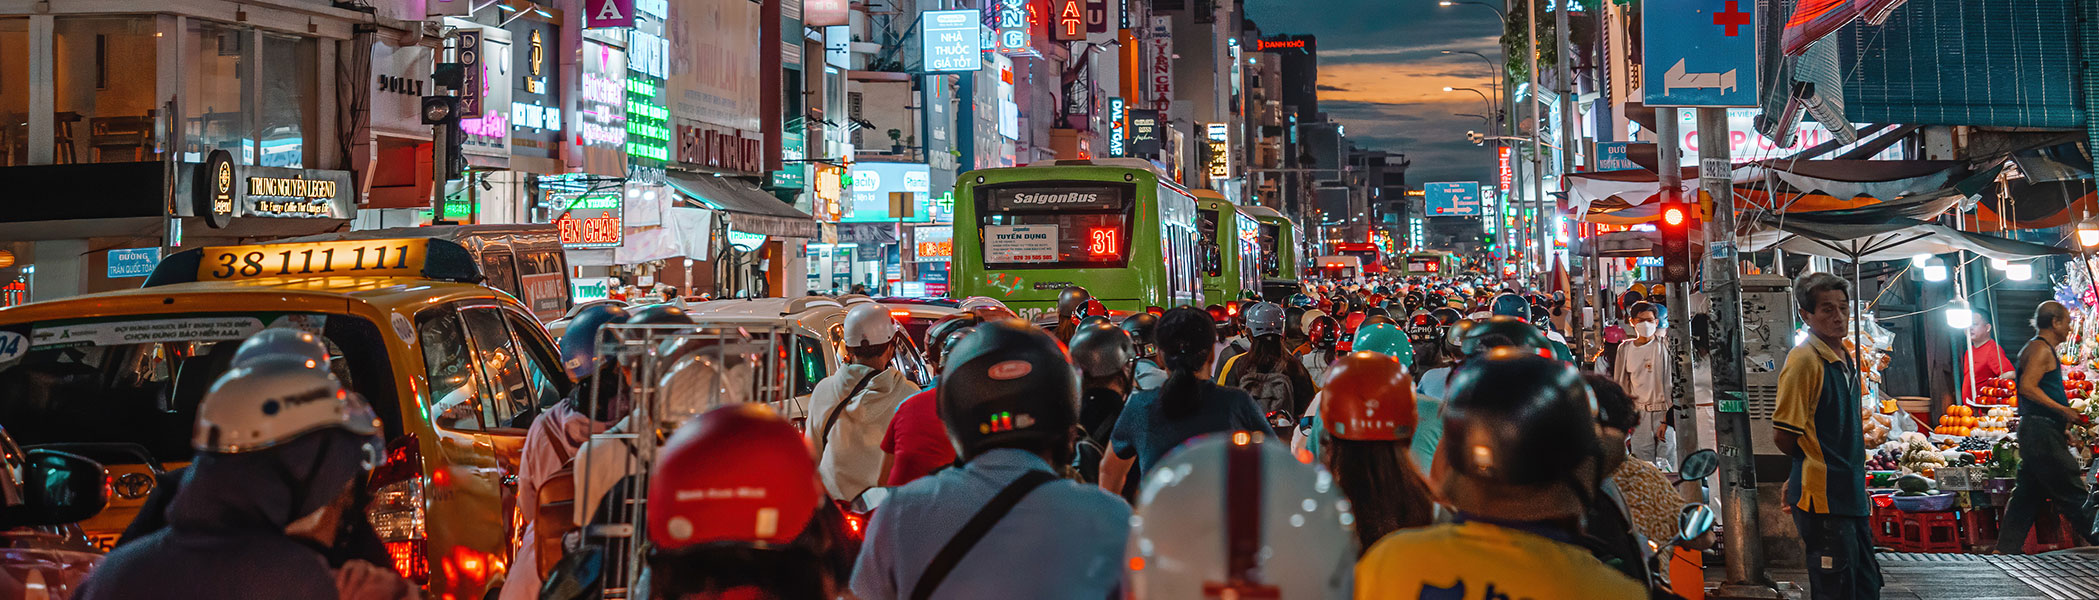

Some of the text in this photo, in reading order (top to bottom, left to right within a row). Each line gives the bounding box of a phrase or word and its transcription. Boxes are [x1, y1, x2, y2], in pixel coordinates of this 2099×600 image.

[940, 31, 963, 43] NHÀ
[935, 42, 970, 57] THUỐC
[934, 55, 972, 69] GIÁ TỐT
[461, 34, 476, 113] DOLLY
[1608, 145, 1626, 154] ĐƯỜ
[251, 175, 336, 198] TRUNG NGUYÊN LEGEND
[587, 195, 619, 209] THUỐC
[1013, 193, 1097, 204] SaigonBus
[215, 199, 232, 215] Legend
[583, 211, 619, 243] CHÂU
[1093, 231, 1116, 254] 31
[119, 252, 149, 262] ĐƯỜNG
[213, 245, 409, 280] 38 111 111
[578, 281, 606, 298] THUỐC
